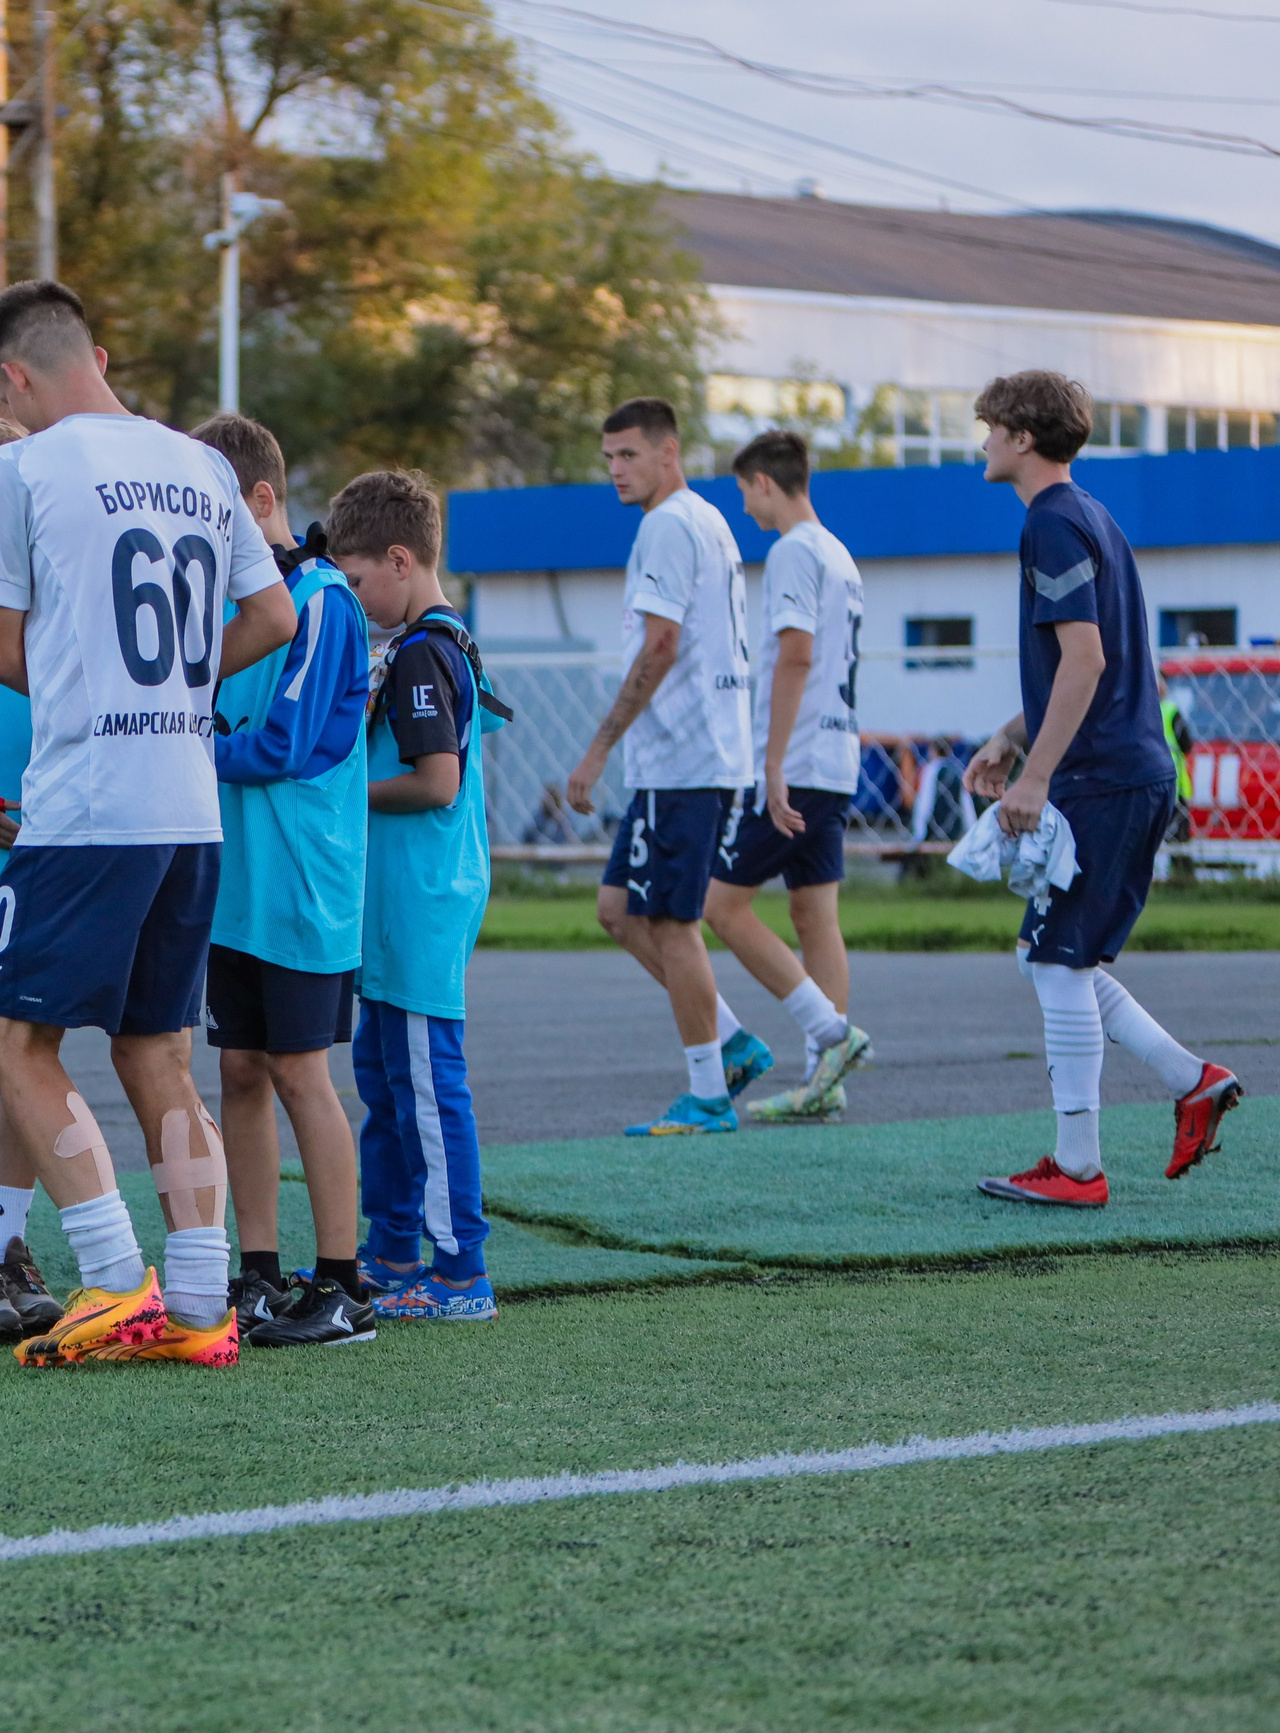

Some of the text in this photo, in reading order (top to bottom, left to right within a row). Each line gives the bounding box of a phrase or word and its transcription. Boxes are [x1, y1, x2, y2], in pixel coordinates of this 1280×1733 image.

[95, 480, 212, 523] БОРИСОВ
[111, 527, 217, 689] 60
[93, 711, 185, 737] САМАРСКАЯ
